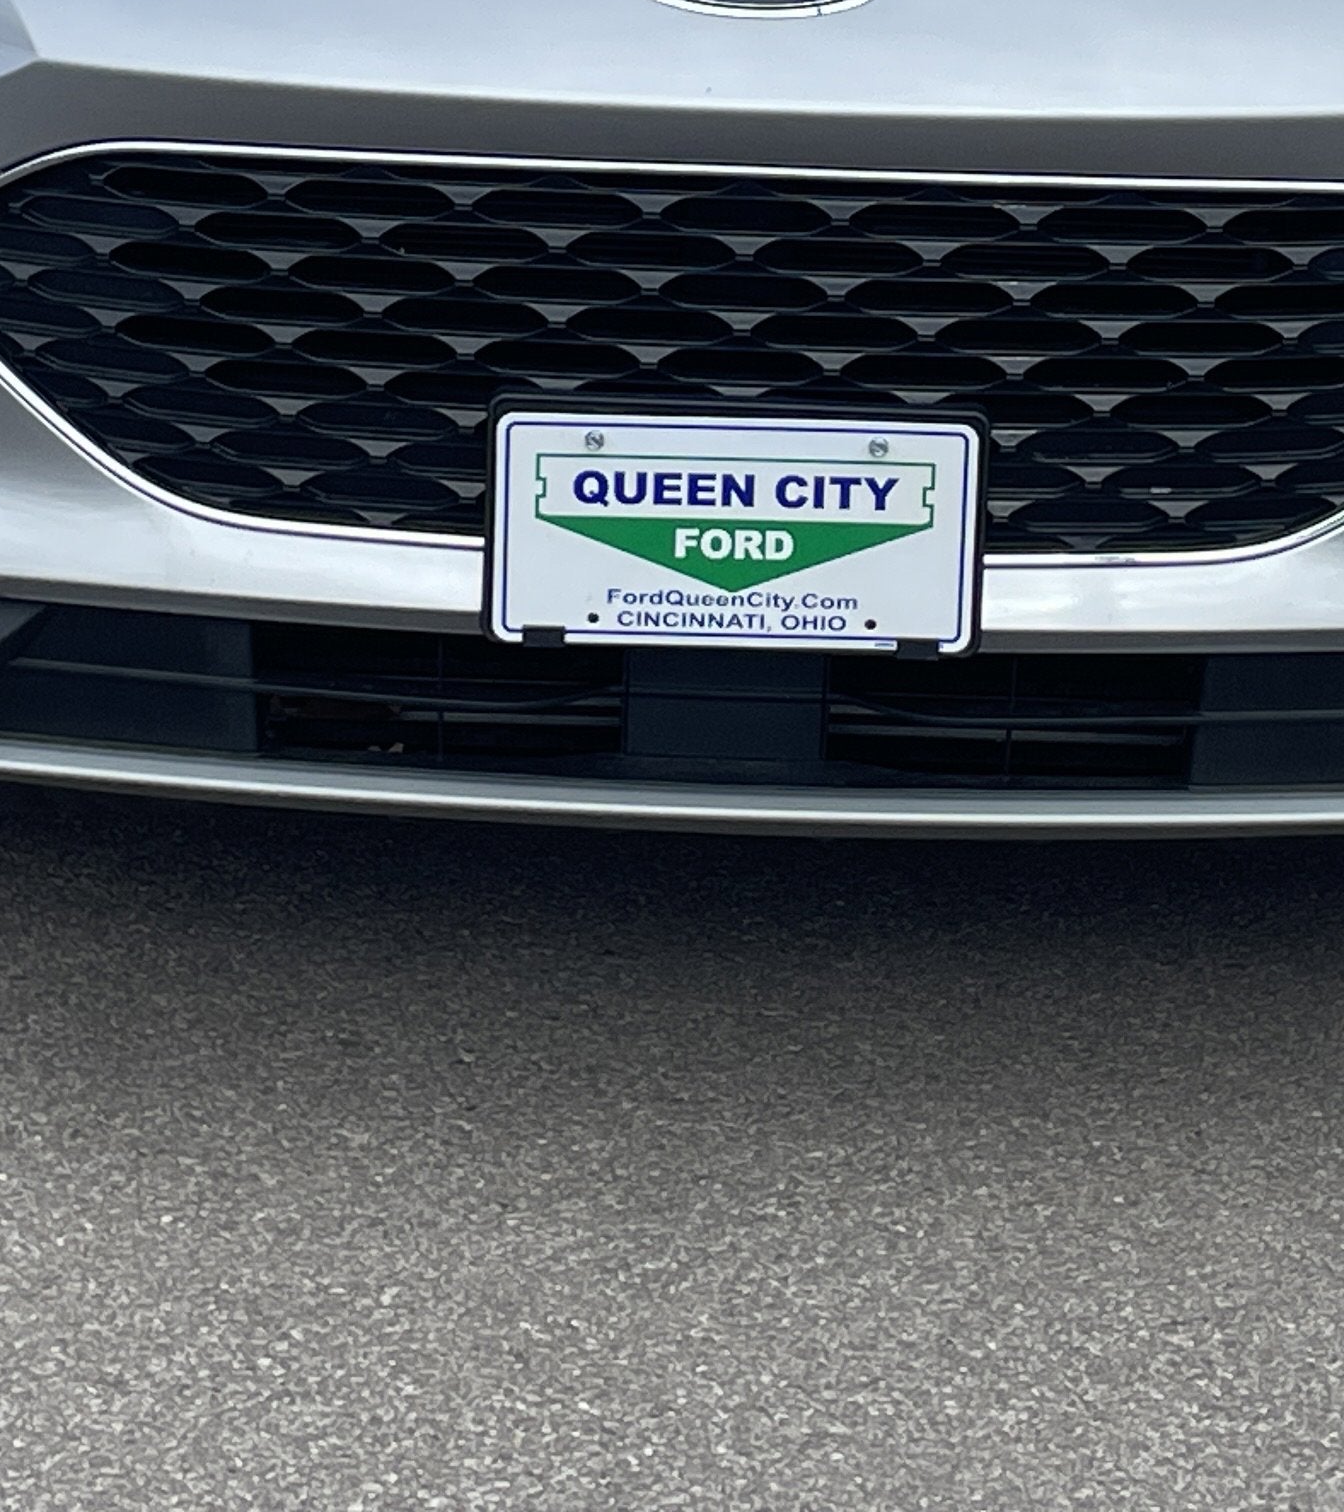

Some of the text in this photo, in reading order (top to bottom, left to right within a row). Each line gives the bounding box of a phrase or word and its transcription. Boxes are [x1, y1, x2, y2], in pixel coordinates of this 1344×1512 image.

[573, 470, 900, 511] QUEEN CITY
[673, 527, 794, 561] FORD
[607, 588, 858, 613] FordQueenCity.Com
[616, 610, 847, 633] CINCINNATI, OHIO
